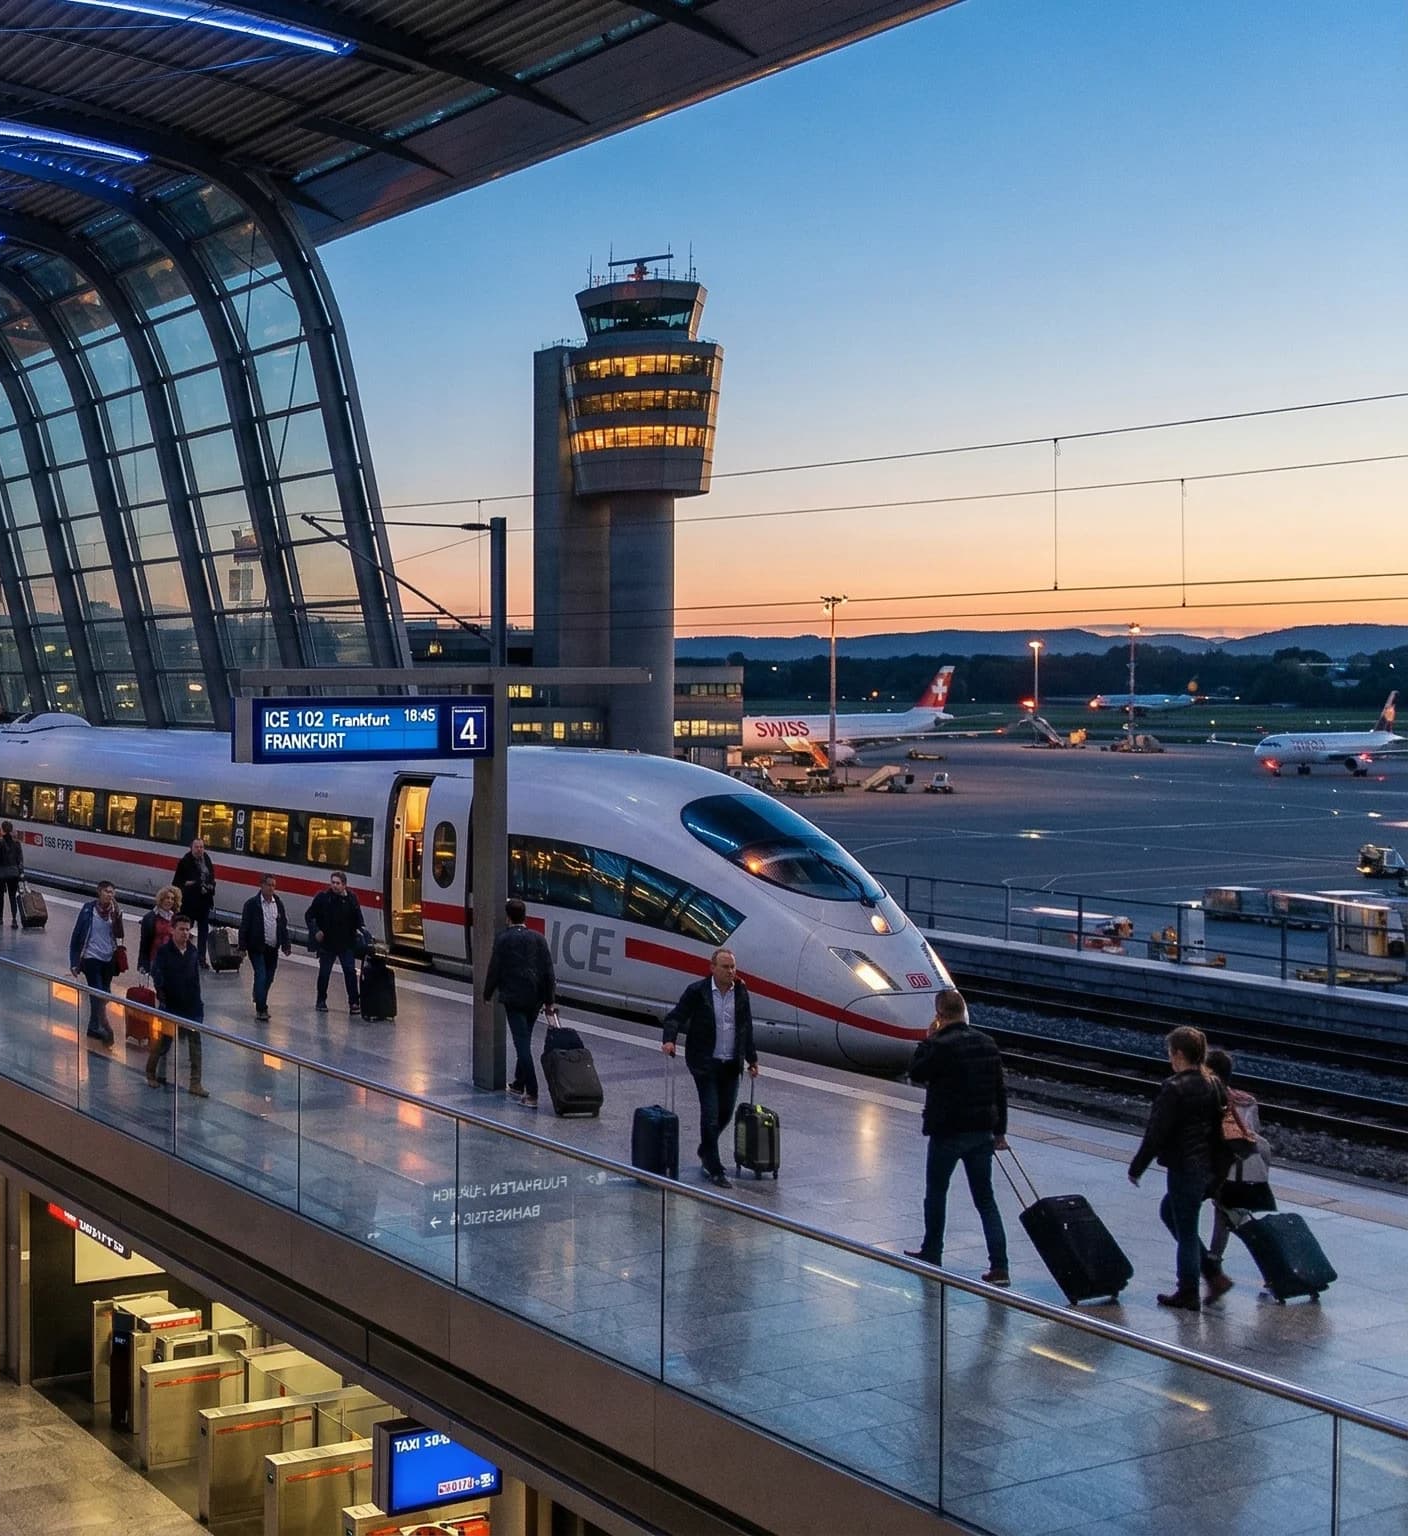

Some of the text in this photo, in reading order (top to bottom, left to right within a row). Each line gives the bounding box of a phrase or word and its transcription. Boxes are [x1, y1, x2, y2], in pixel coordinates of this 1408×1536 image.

[265, 708, 436, 728] ICE 102 Frankfurt 18:45
[460, 717, 478, 745] 4
[756, 720, 810, 738] SWISS
[265, 732, 346, 750] FRANKFURT
[551, 921, 617, 976] ICE
[395, 1438, 419, 1453] TAXI
